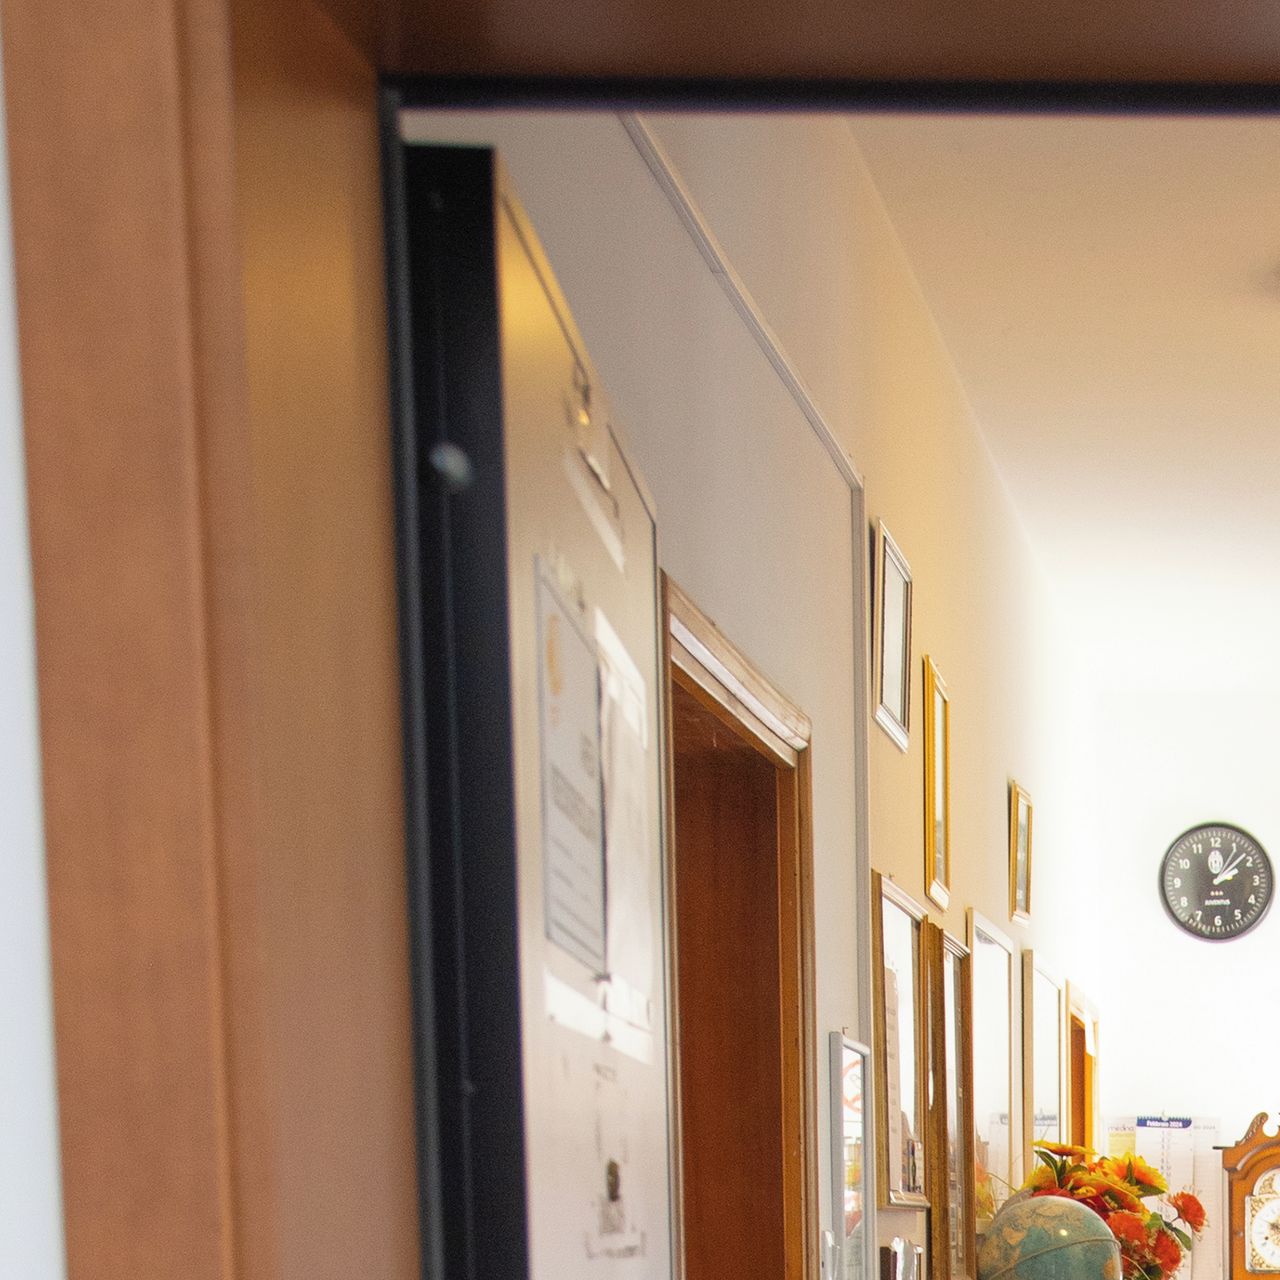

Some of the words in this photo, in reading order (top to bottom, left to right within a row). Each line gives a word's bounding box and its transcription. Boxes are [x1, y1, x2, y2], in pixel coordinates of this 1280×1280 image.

[1210, 837, 1221, 848] 12
[1192, 843, 1203, 854] 11
[1179, 858, 1190, 869] 10
[1246, 856, 1253, 867] 2
[1173, 877, 1181, 888] 9
[1252, 875, 1260, 886] 3
[1180, 897, 1188, 907] 8
[1247, 894, 1255, 904] 4
[1195, 911, 1202, 921] 7
[1234, 909, 1242, 920] 5
[1214, 916, 1222, 926] 6
